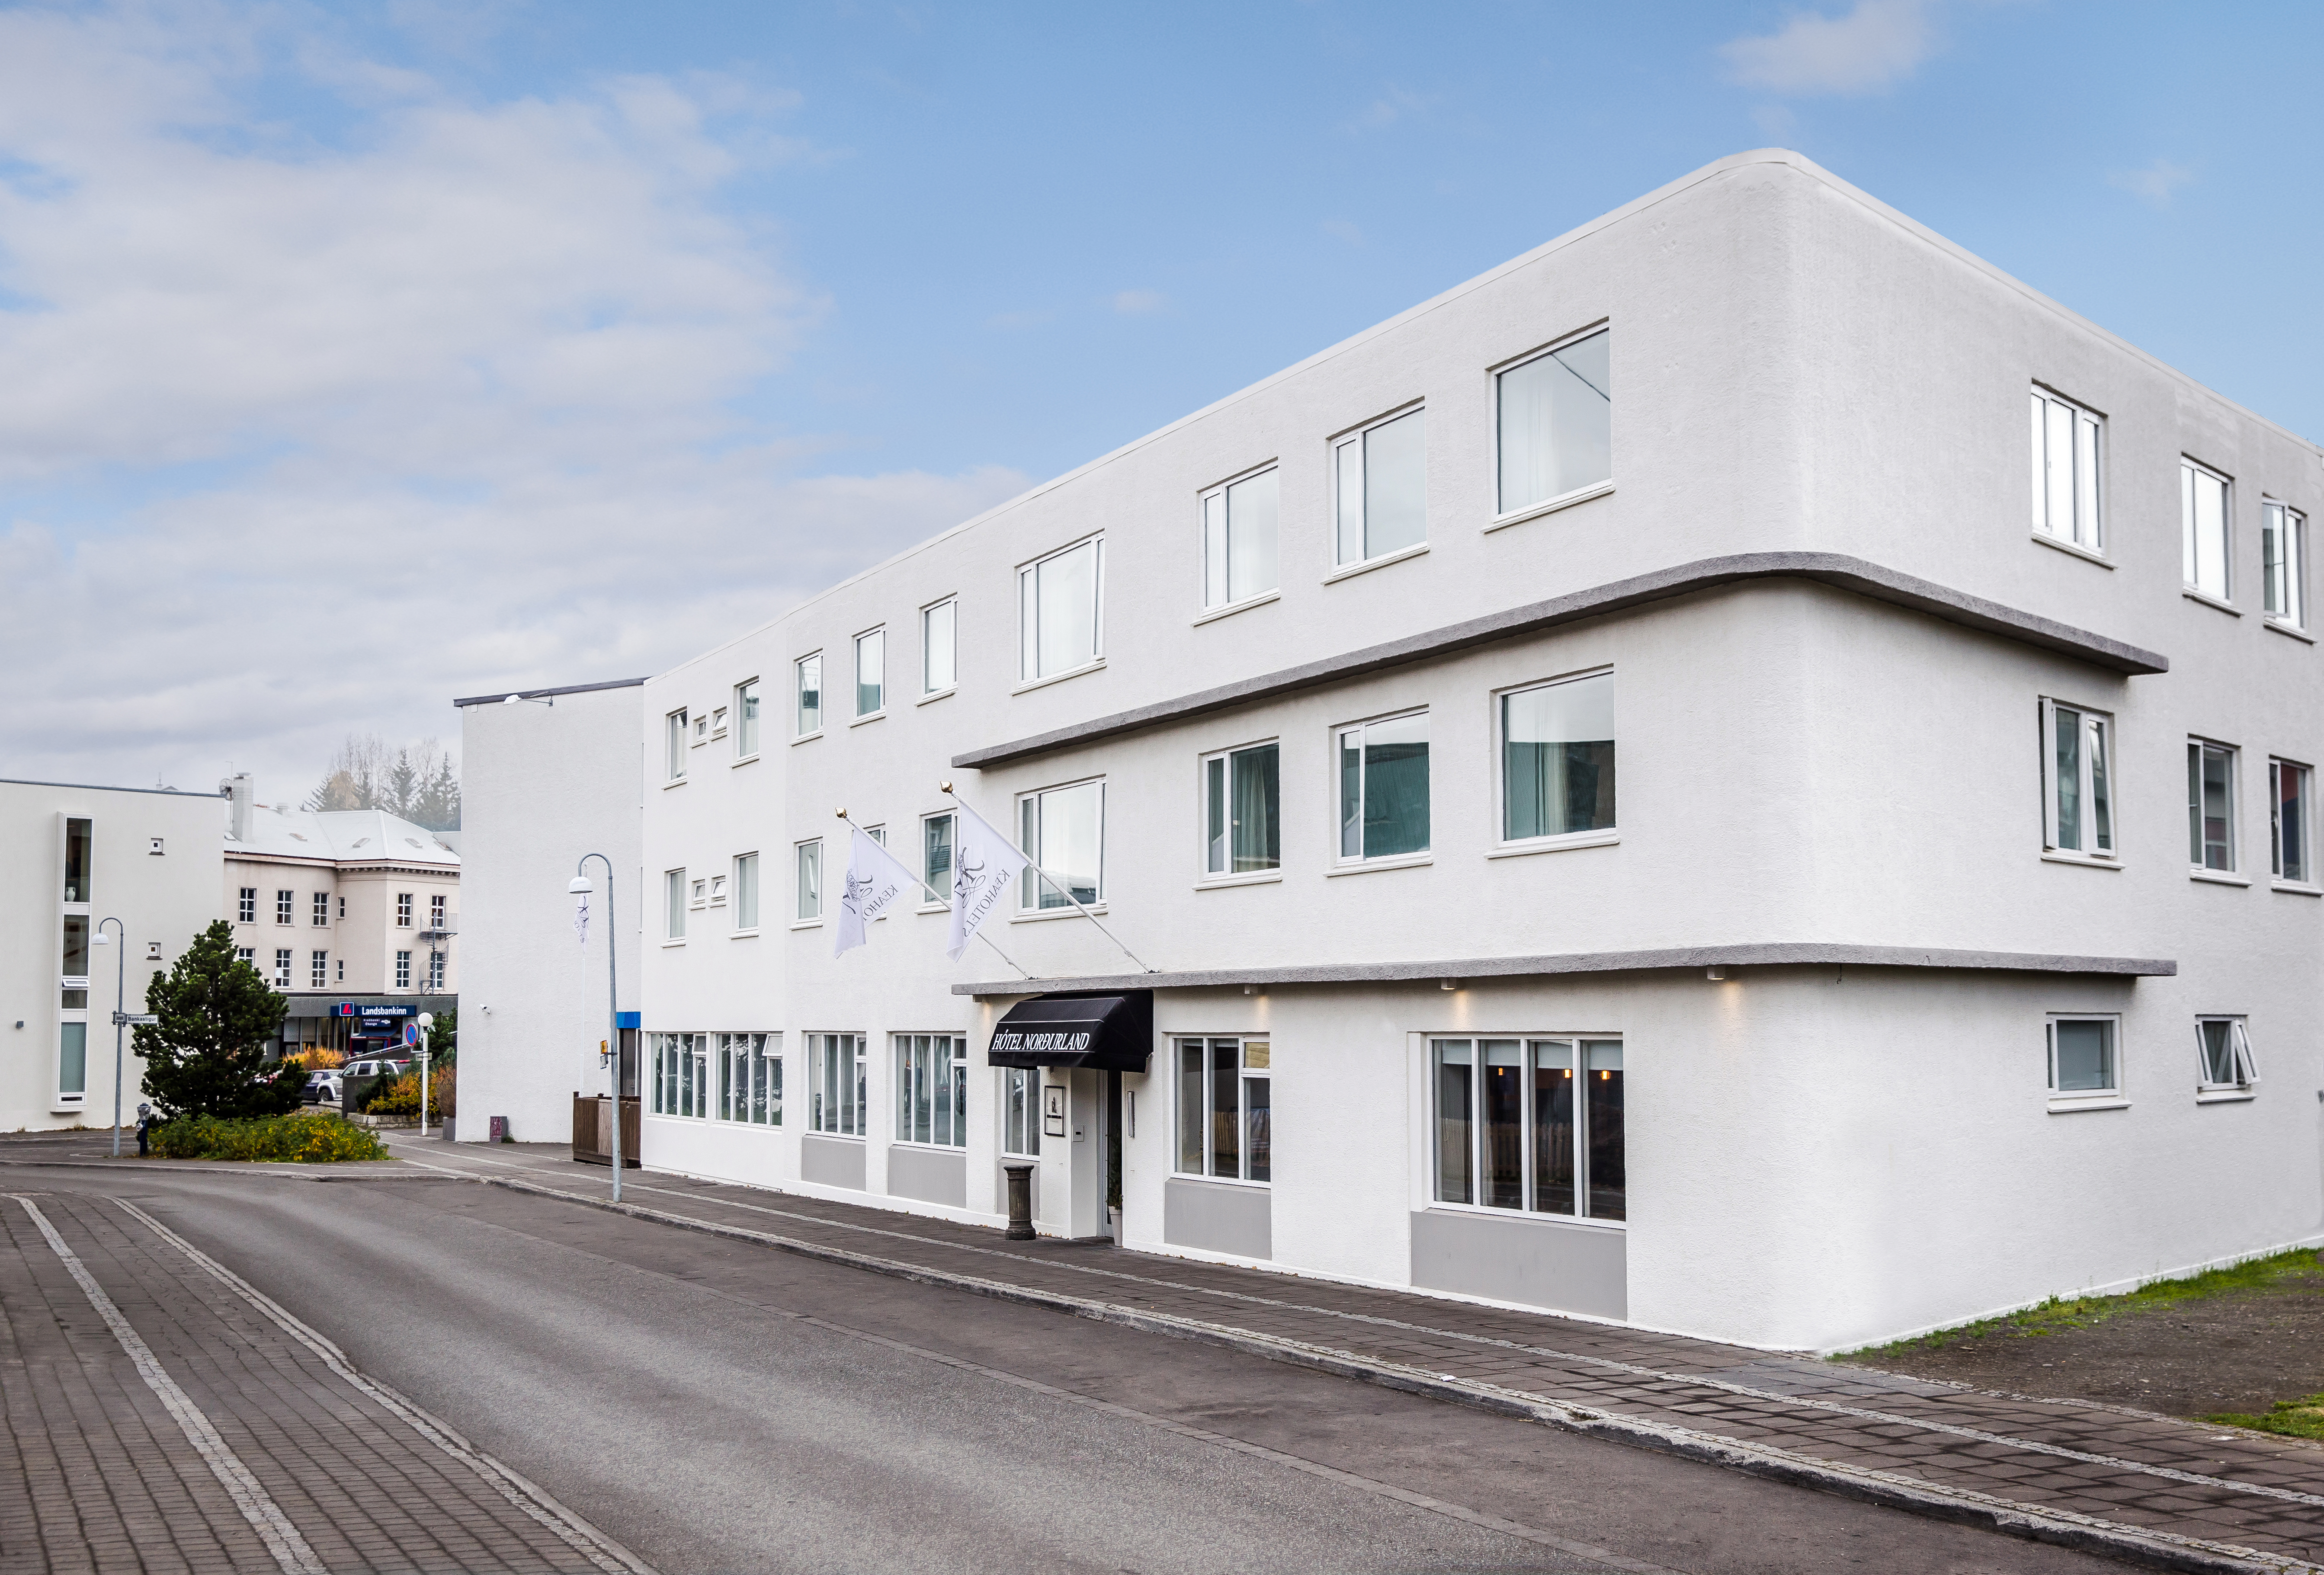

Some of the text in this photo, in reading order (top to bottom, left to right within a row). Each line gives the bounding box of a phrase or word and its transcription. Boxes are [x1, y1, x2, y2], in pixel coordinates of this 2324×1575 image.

[362, 1006, 407, 1015] Landsbankinn
[991, 1029, 1090, 1050] HÓTEL NORÐURLAND
